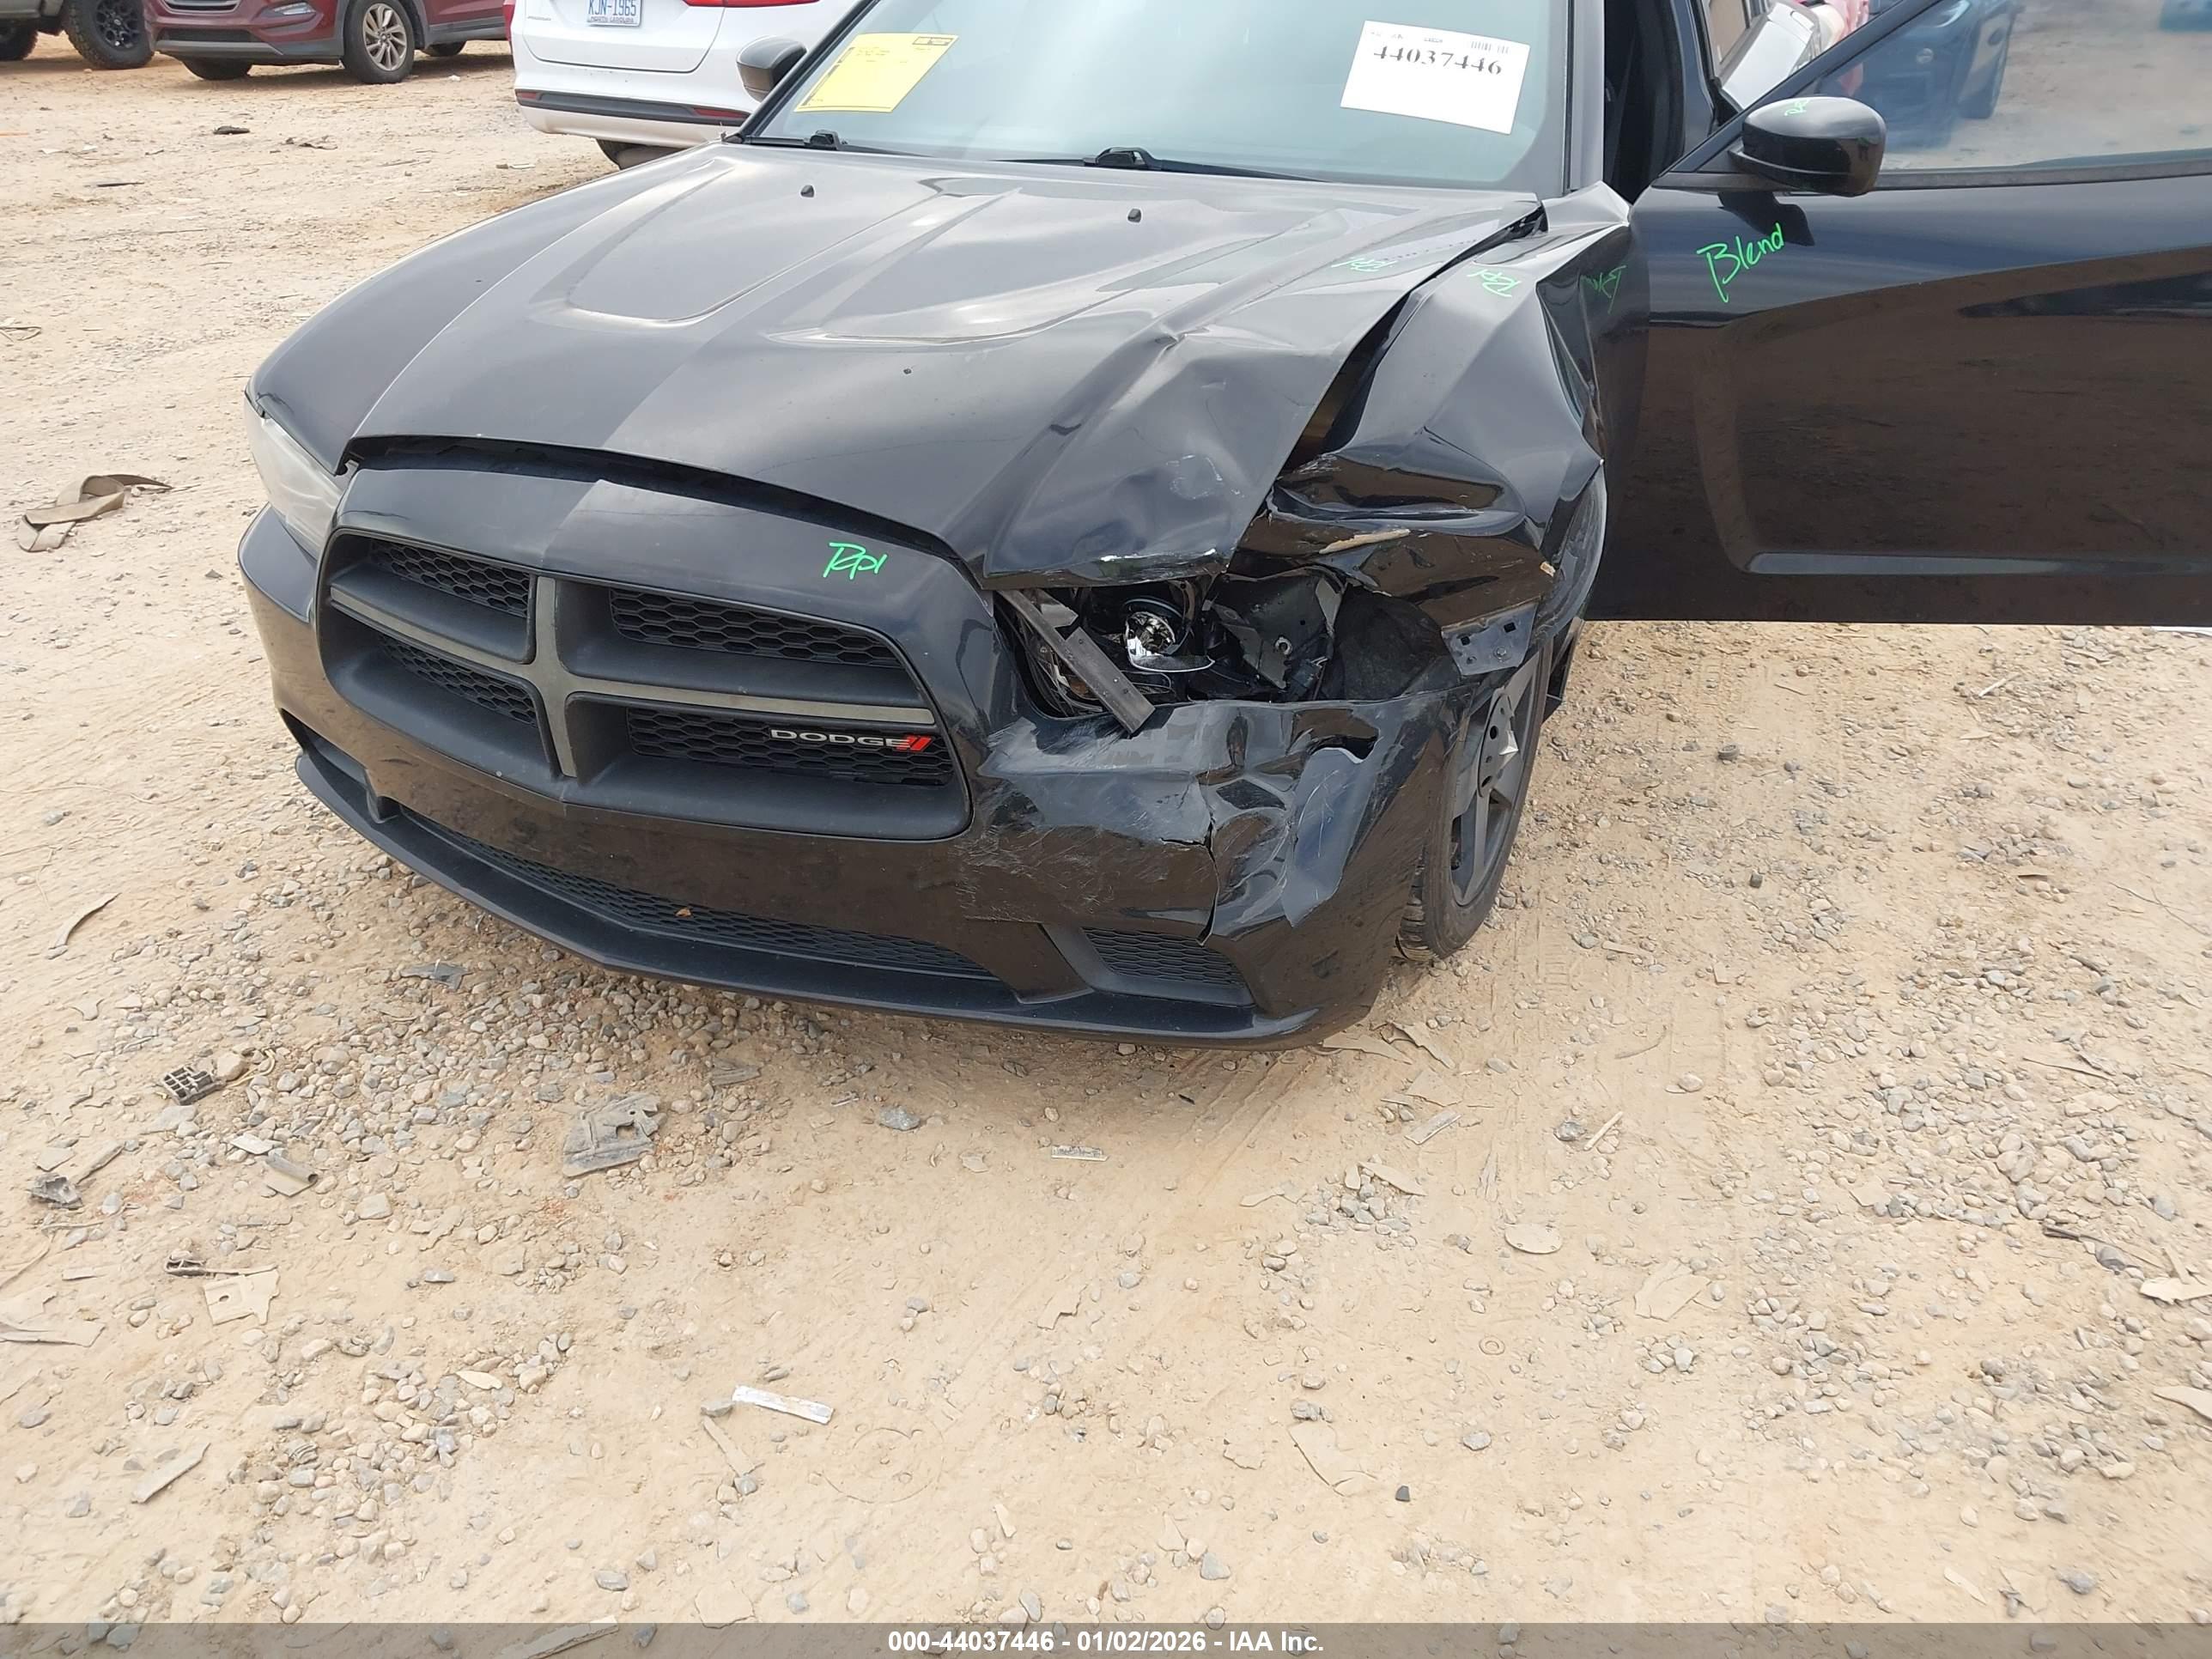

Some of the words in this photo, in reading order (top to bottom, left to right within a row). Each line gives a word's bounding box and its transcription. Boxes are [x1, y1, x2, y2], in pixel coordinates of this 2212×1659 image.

[1373, 46, 1502, 75] 44037446
[1696, 222, 1785, 303] Blend
[770, 729, 912, 750] DODGE
